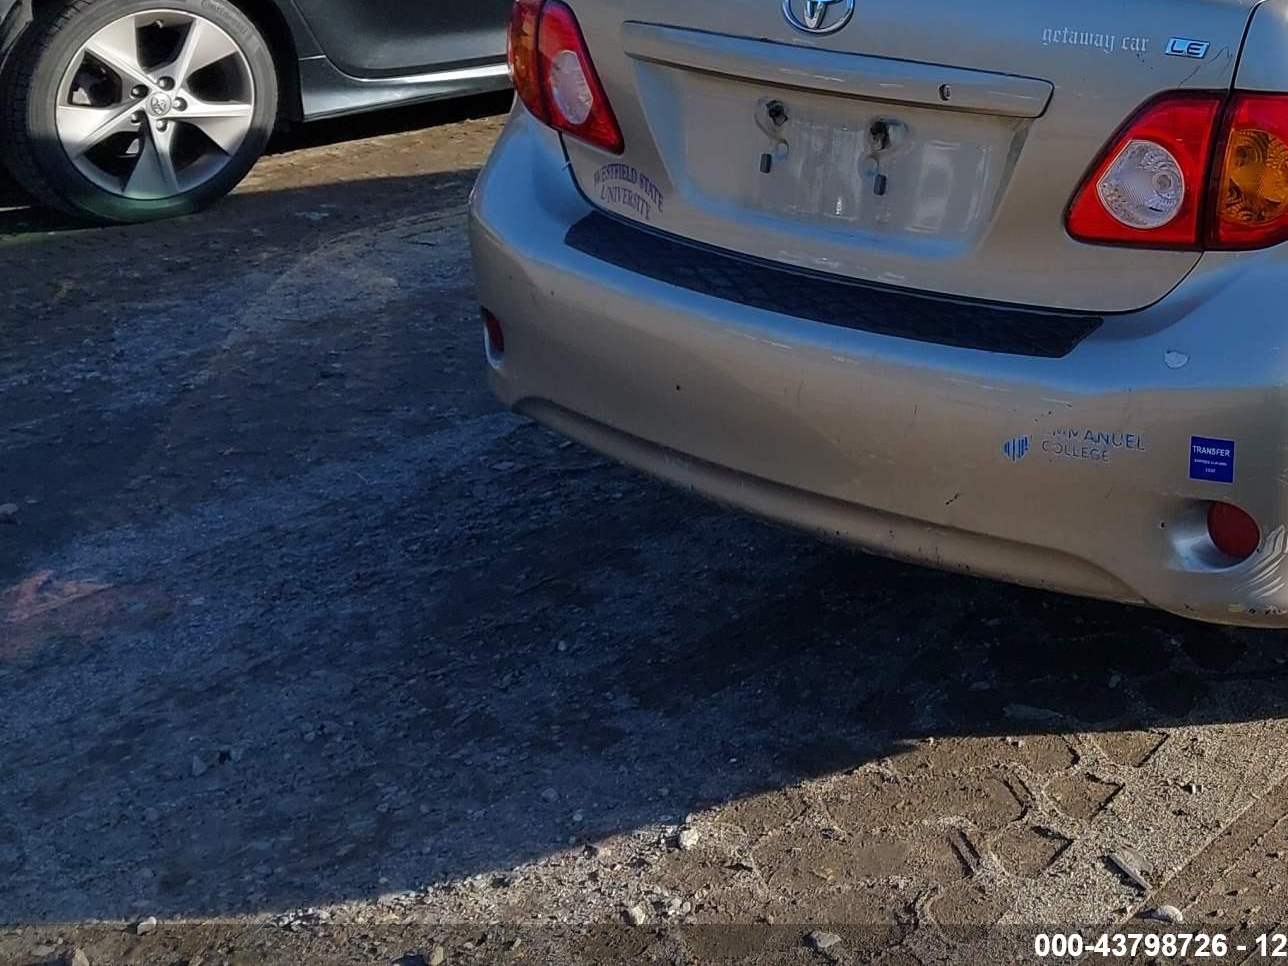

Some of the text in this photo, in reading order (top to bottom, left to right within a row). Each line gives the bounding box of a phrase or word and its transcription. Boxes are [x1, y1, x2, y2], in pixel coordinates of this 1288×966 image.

[1042, 27, 1150, 53] getaway car
[1169, 39, 1206, 56] LE
[593, 163, 664, 213] WESTFIELD STATE
[600, 184, 651, 221] UNIVERSITY
[1192, 445, 1231, 458] TRANSFER
